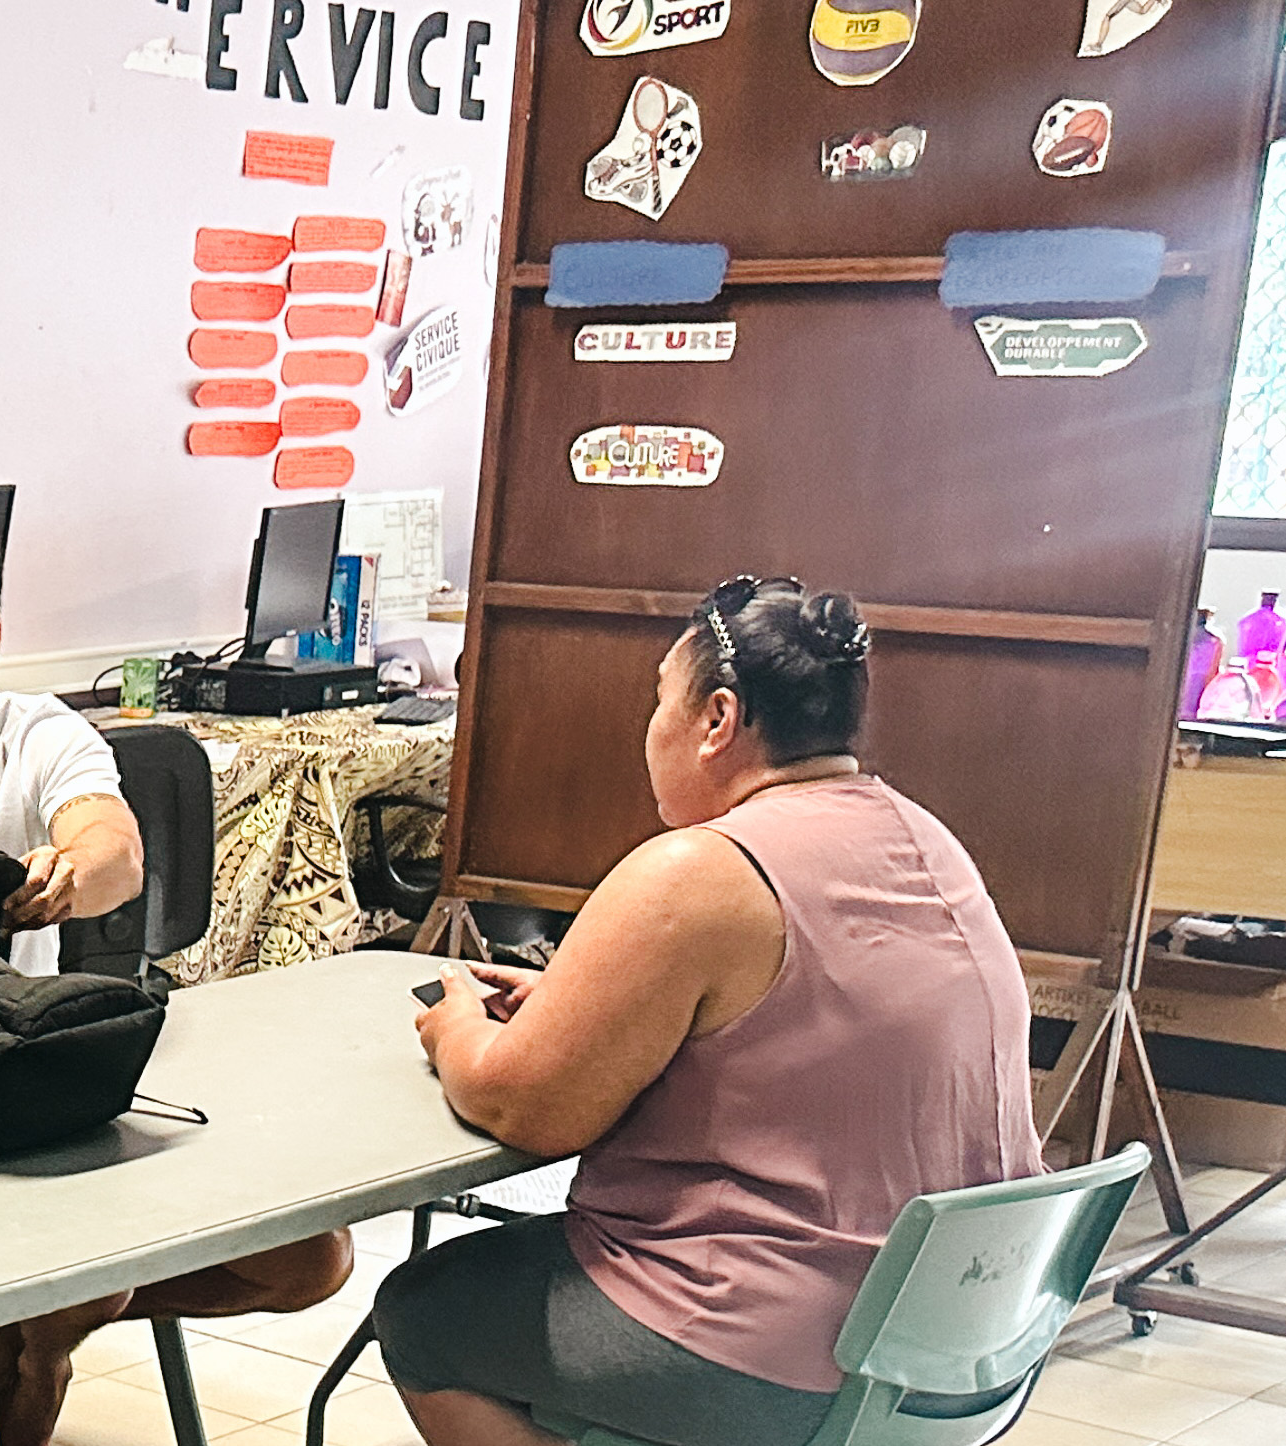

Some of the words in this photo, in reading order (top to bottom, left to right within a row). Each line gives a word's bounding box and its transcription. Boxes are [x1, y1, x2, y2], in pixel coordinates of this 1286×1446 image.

[653, 1, 724, 35] SPORT
[155, 0, 491, 121] ERVICE
[414, 311, 459, 350] SERVICE
[578, 330, 733, 351] CULTURE
[415, 332, 461, 373] CIVIQUE
[1004, 348, 1066, 359] DURABLE
